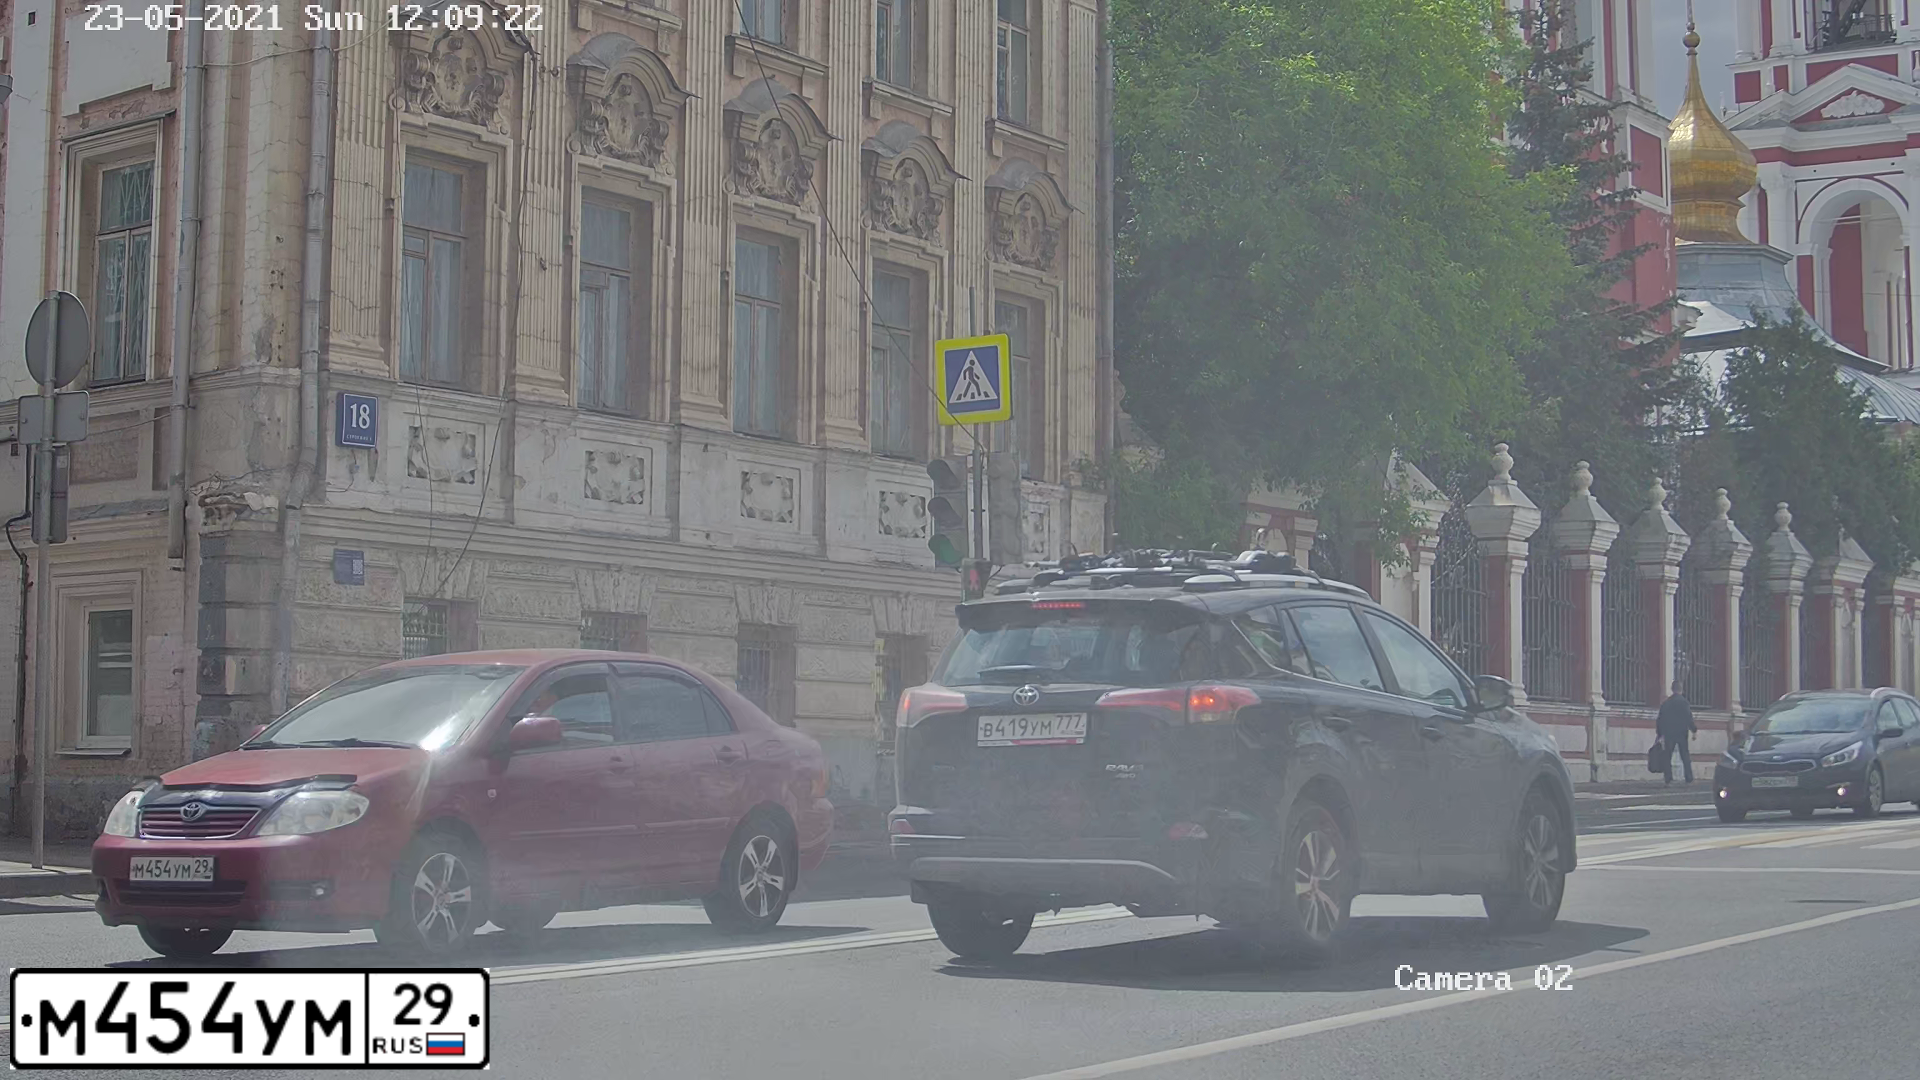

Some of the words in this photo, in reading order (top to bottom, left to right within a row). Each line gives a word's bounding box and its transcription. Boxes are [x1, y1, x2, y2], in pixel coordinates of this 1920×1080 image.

[350, 403, 370, 429] 18
[1056, 714, 1082, 730] 777
[134, 859, 191, 879] М454УМ
[194, 859, 209, 874] 29
